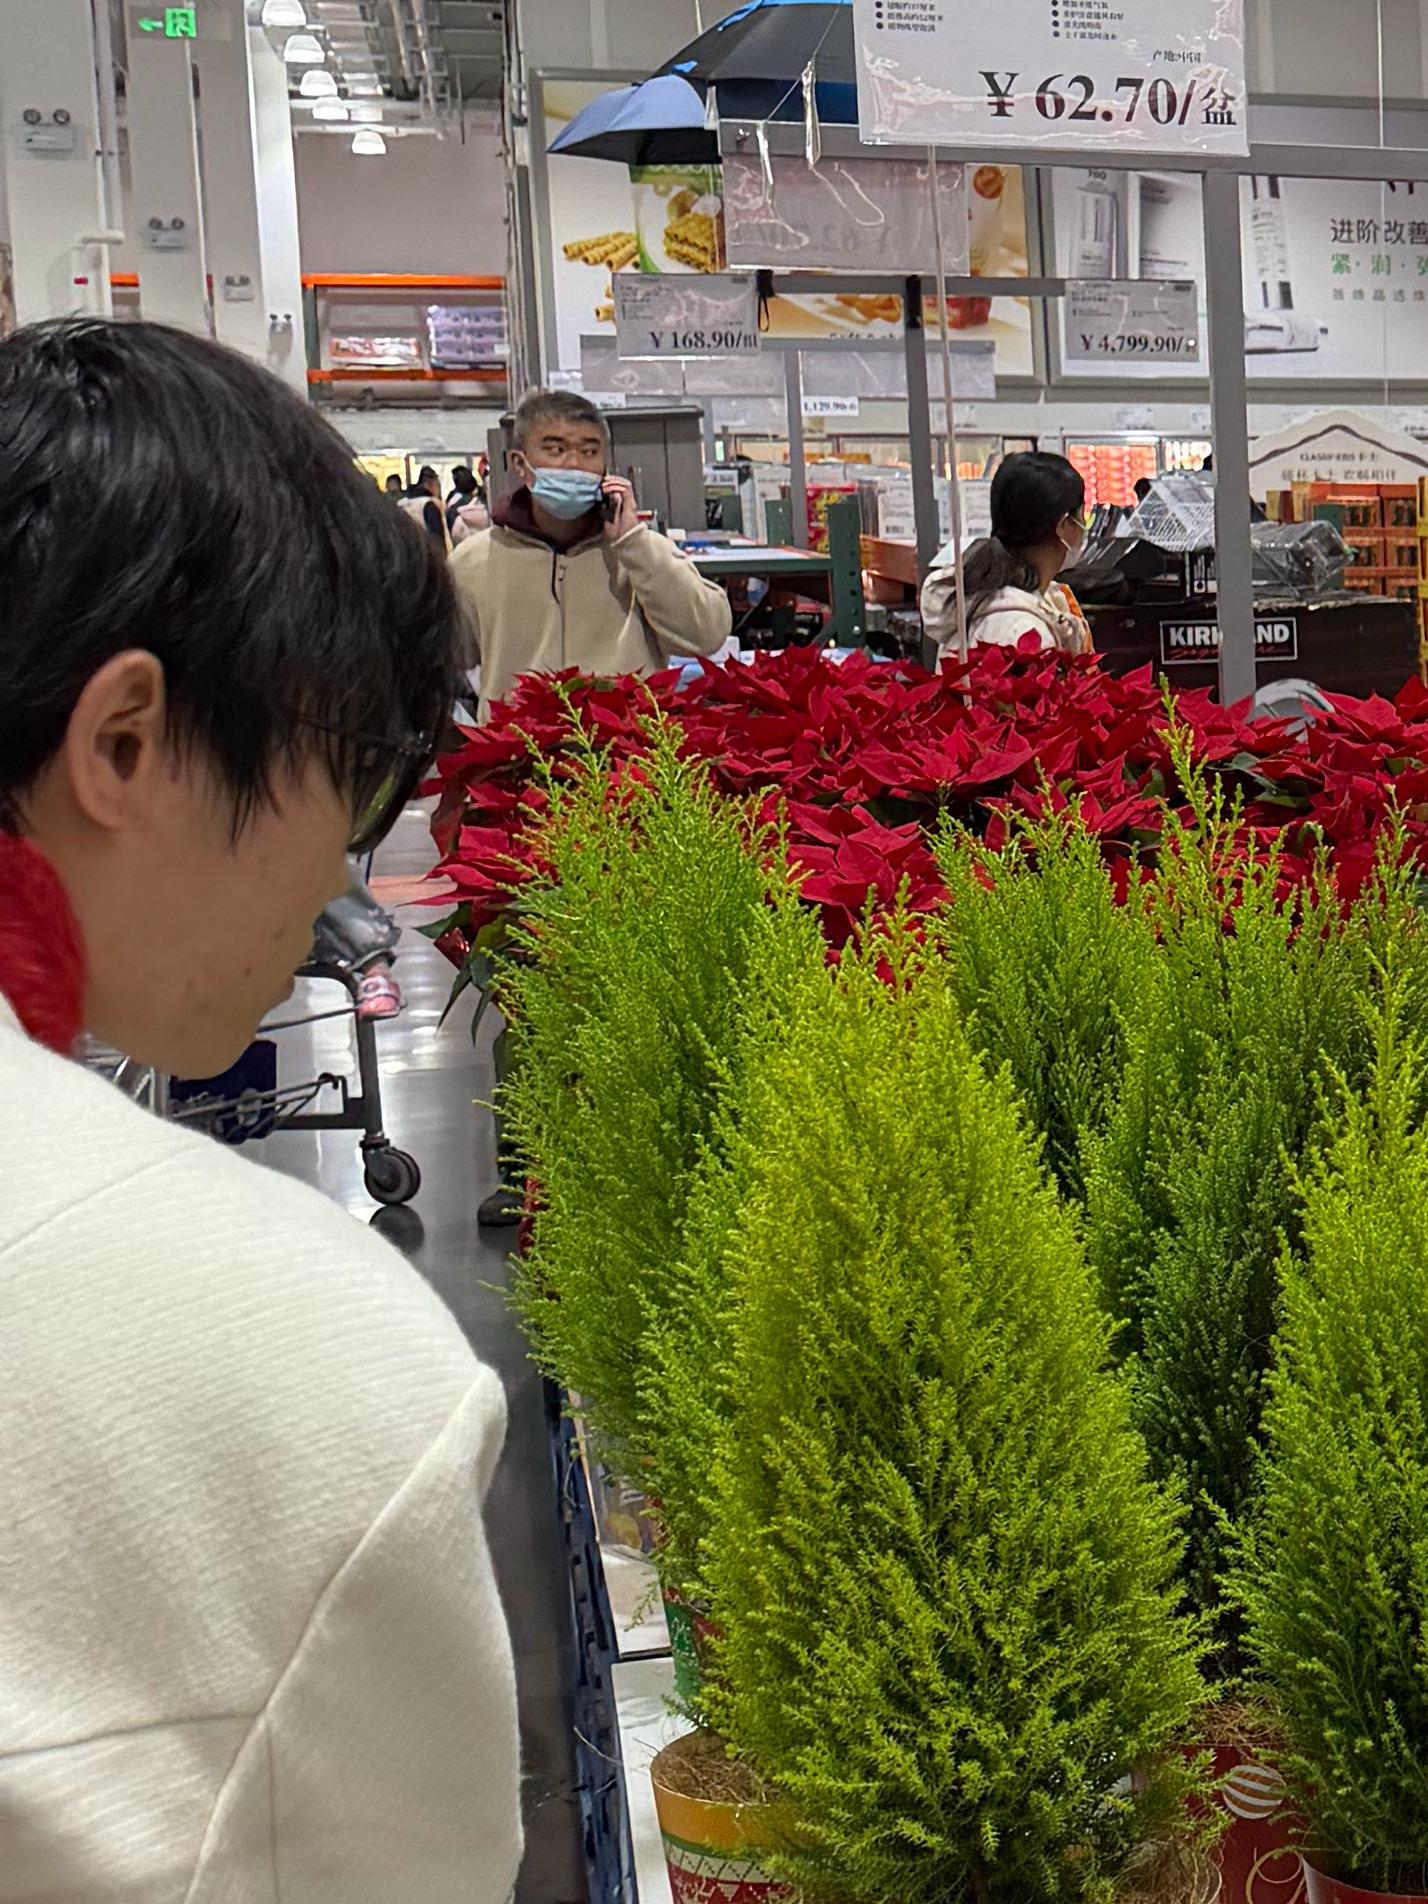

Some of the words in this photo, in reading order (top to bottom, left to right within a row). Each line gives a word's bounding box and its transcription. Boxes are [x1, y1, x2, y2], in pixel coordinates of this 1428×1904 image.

[979, 71, 1019, 117] ¥
[1035, 72, 1236, 126] 62.70/盆
[1098, 335, 1197, 353] 4,799.90/
[1169, 624, 1290, 647] KIRND
